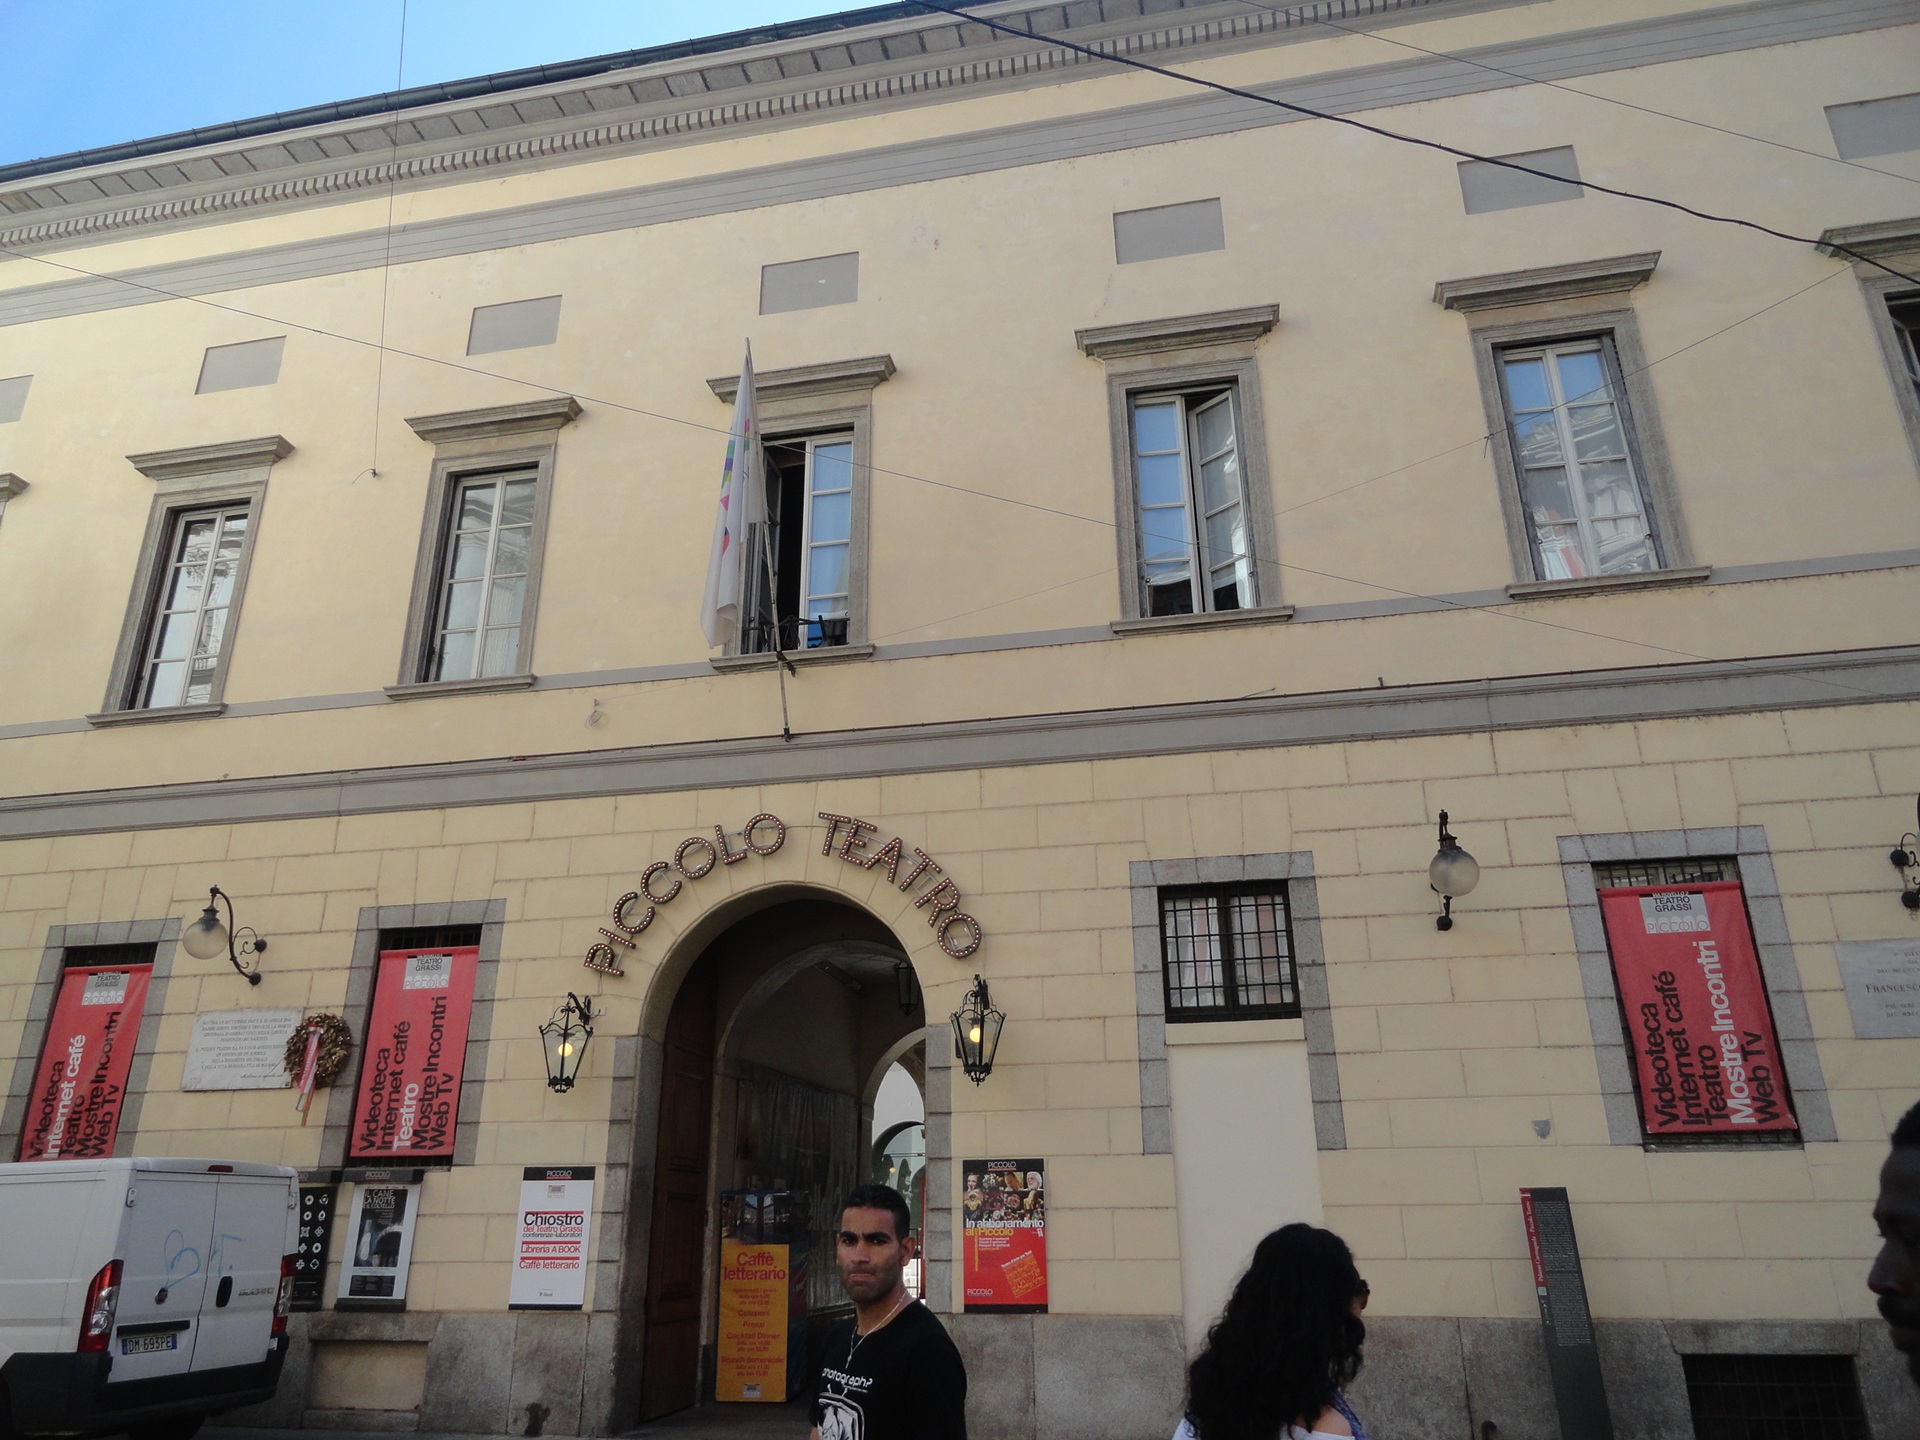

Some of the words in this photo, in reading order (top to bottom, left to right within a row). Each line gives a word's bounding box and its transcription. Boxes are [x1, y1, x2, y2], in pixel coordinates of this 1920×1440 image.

[583, 812, 786, 978] PICCOLO
[818, 811, 982, 959] TEATRO
[1653, 895, 1690, 905] TEATRO
[1654, 903, 1693, 913] GRASSI
[1646, 919, 1709, 934] PICCOLO
[415, 964, 442, 972] GRASSI
[416, 957, 443, 965] TEATRO
[94, 980, 119, 988] GRASSI
[96, 974, 121, 982] TEATRO
[404, 978, 449, 989] PICCOLO
[1692, 939, 1735, 1032] Incontri
[1651, 969, 1684, 1023] café
[422, 995, 448, 1073] Incontri
[1740, 1030, 1763, 1063] Tv
[1640, 1002, 1681, 1128] Videoteca
[1666, 1027, 1706, 1126] Internet
[1719, 1032, 1757, 1125] Mostre
[42, 1080, 76, 1159] Internet
[67, 1034, 86, 1077] café
[73, 1084, 104, 1157] Mostre
[90, 1011, 122, 1084] Incontri
[100, 1083, 120, 1110] Tv
[376, 1069, 404, 1151] Internet
[393, 1020, 411, 1065] café
[435, 1072, 454, 1098] Tv
[1697, 1044, 1730, 1126] Teatro
[1747, 1064, 1780, 1125] Web
[28, 1060, 65, 1159] Videoteca
[359, 1047, 391, 1152] Videoteca
[410, 1074, 437, 1150] Mostre
[59, 1094, 86, 1157] Teatro
[392, 1083, 419, 1151] Teatro
[428, 1102, 450, 1151] Web
[89, 1112, 114, 1158] Web
[988, 1161, 1016, 1169] PICCOLO
[523, 1212, 584, 1226] Chiostro
[523, 1225, 535, 1233] del
[536, 1225, 558, 1233] Teatro
[559, 1224, 583, 1233] Grassi
[965, 1218, 976, 1228] In
[976, 1218, 1044, 1229] abbonamento
[965, 1228, 975, 1236] al
[978, 1227, 1014, 1236] Piccolo
[520, 1244, 550, 1254] Libreria
[558, 1245, 581, 1253] BOOK
[736, 1251, 774, 1267] Caffè
[519, 1259, 541, 1269] Caffè
[542, 1260, 580, 1269] letterario
[723, 1266, 786, 1281] letterario
[967, 1288, 993, 1296] PICCOLO
[128, 1339, 140, 1351] DM
[143, 1335, 172, 1350] 693PE
